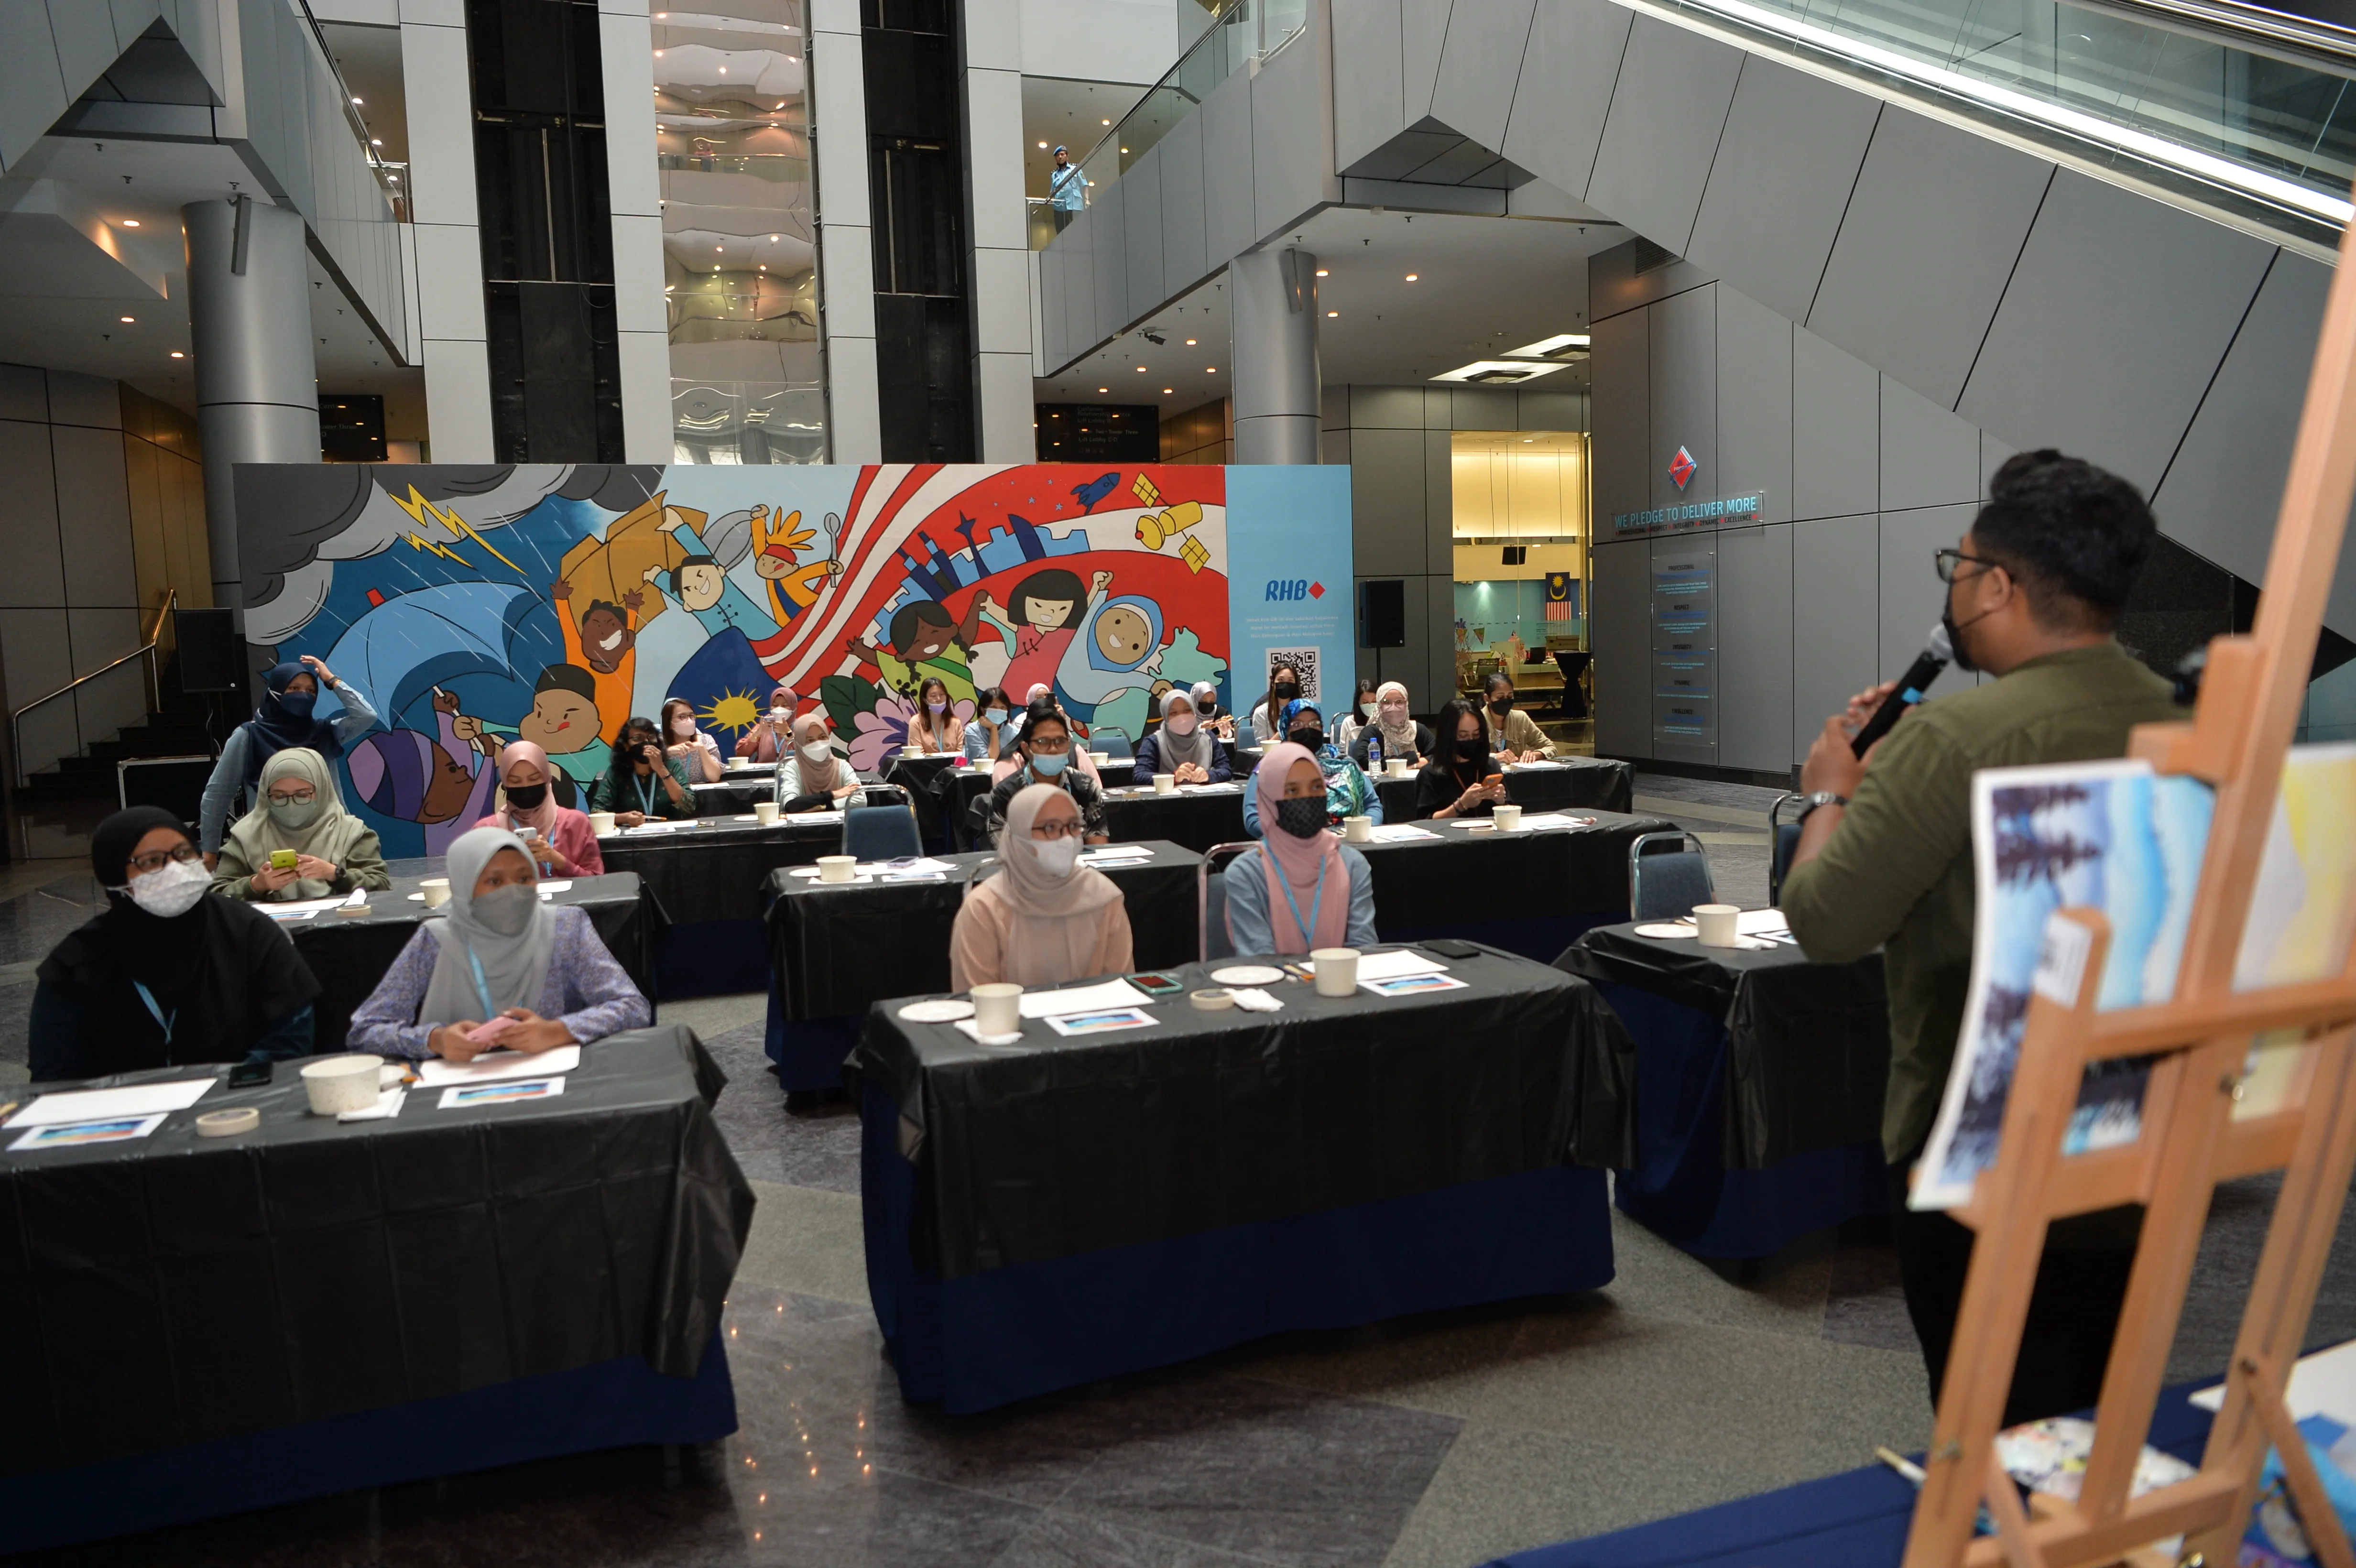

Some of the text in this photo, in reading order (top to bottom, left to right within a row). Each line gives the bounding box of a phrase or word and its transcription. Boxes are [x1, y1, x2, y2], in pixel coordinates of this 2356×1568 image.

[1615, 496, 1756, 528] WE PLEDGE TO DELIVER MORE
[1699, 518, 1720, 526] DYNAMIC
[1724, 514, 1752, 523] EXCELLENCE
[1265, 579, 1308, 601] RHB
